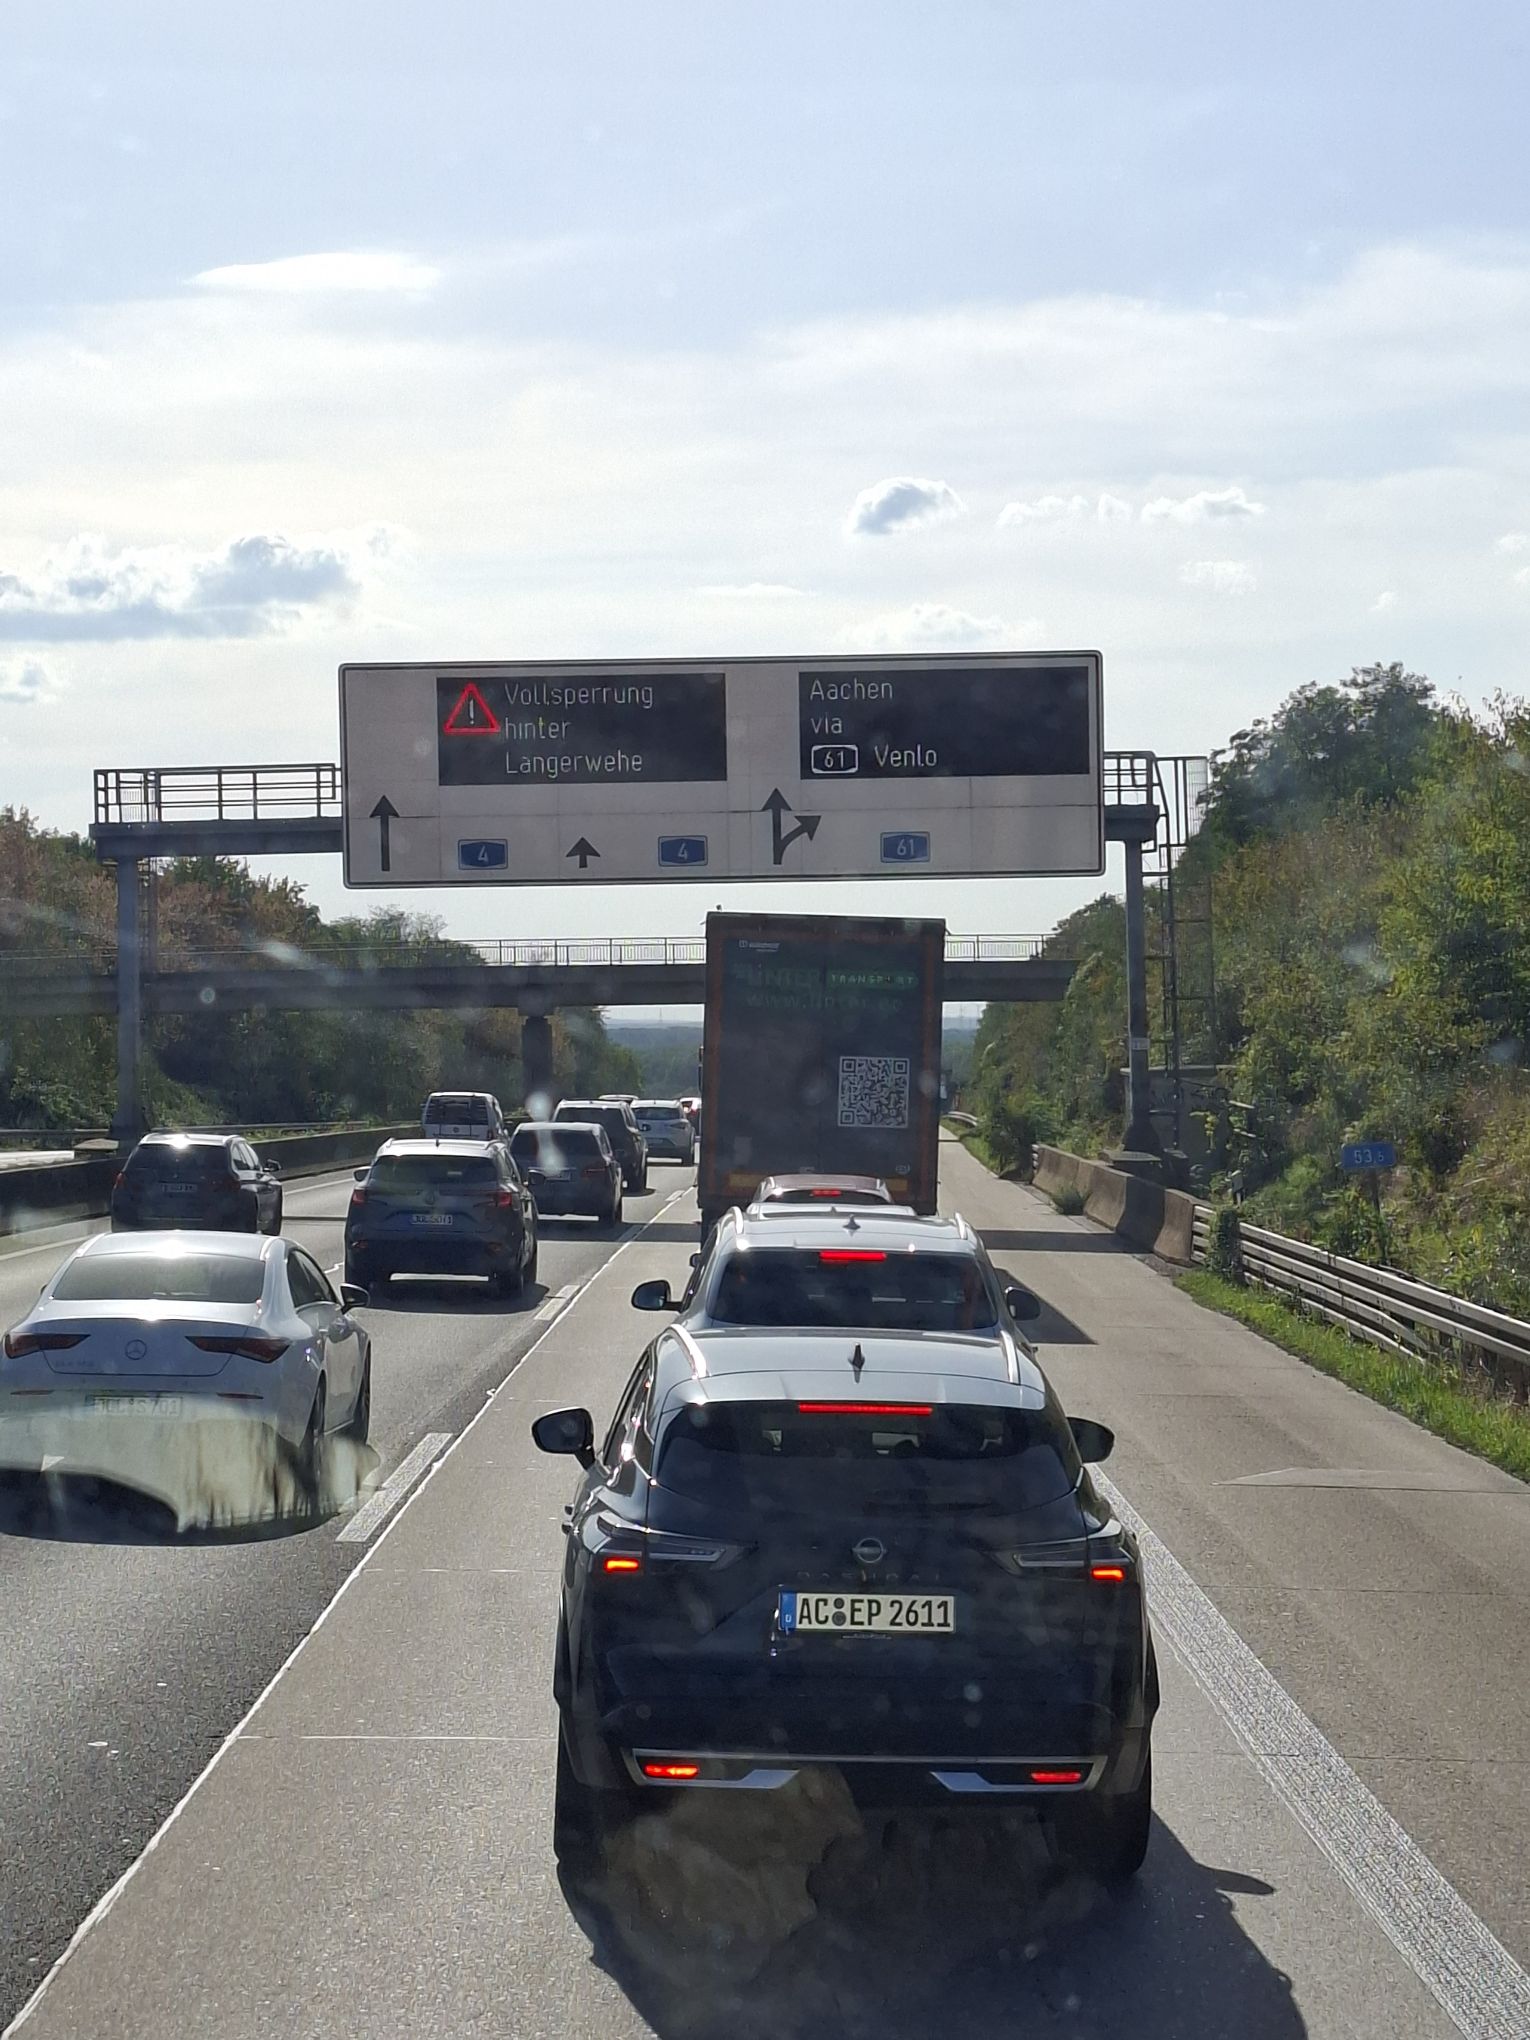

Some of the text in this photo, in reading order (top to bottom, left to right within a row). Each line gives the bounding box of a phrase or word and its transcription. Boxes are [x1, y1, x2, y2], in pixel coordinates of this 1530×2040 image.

[504, 682, 654, 710] Vollsperrung
[809, 678, 894, 701] Aachen
[503, 716, 571, 741] hinter
[809, 713, 843, 735] via
[505, 749, 643, 779] Langerwehe
[823, 751, 846, 769] 61
[874, 744, 938, 768] Venlo
[477, 845, 490, 864] 4
[677, 842, 688, 861] 4
[896, 838, 916, 857] 61
[798, 1598, 830, 1626] AC
[850, 1599, 882, 1627] EP
[889, 1599, 952, 1628] 2611
